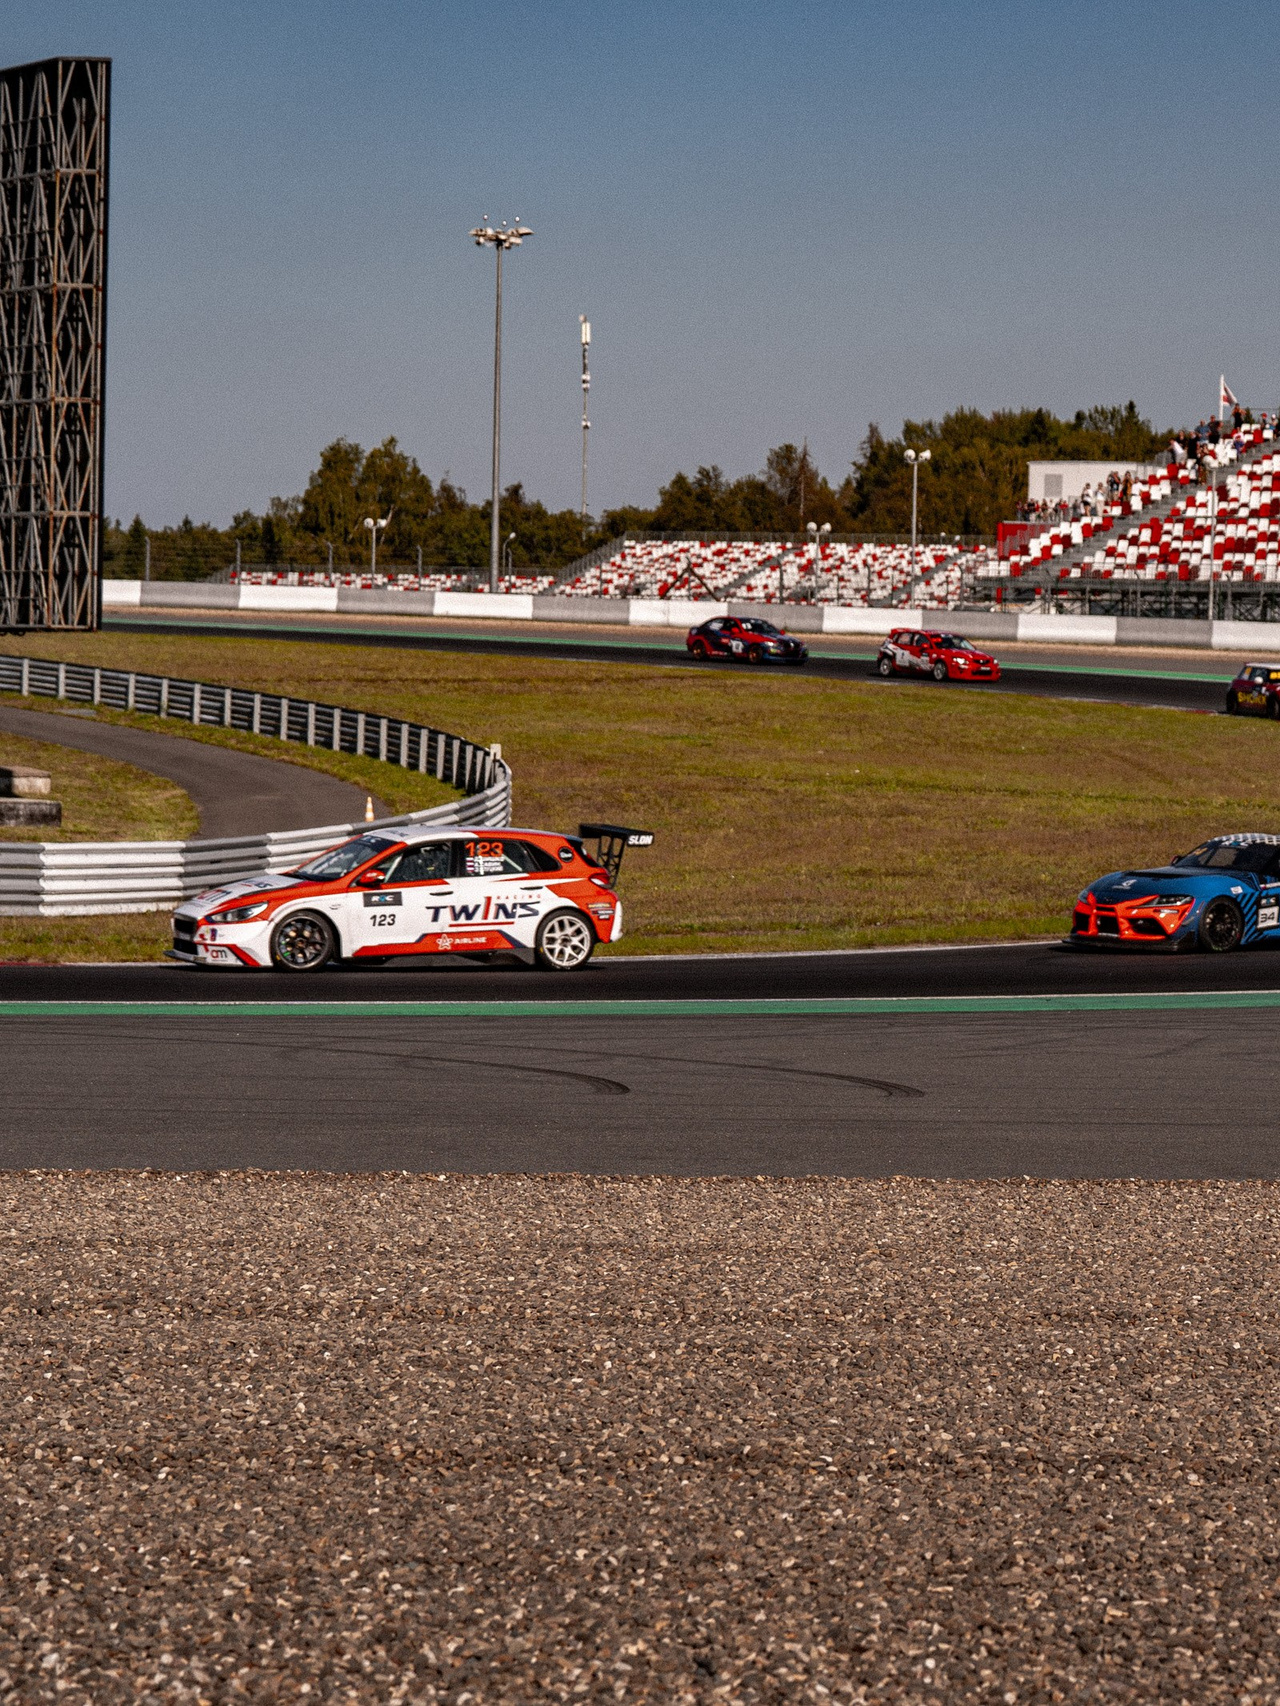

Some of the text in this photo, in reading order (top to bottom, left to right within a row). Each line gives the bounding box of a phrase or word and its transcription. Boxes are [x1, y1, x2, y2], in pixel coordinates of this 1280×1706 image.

[464, 841, 504, 857] 123
[425, 896, 541, 923] TWINS
[369, 914, 396, 926] 123
[1260, 911, 1275, 923] 34
[454, 936, 487, 945] AIRLINE
